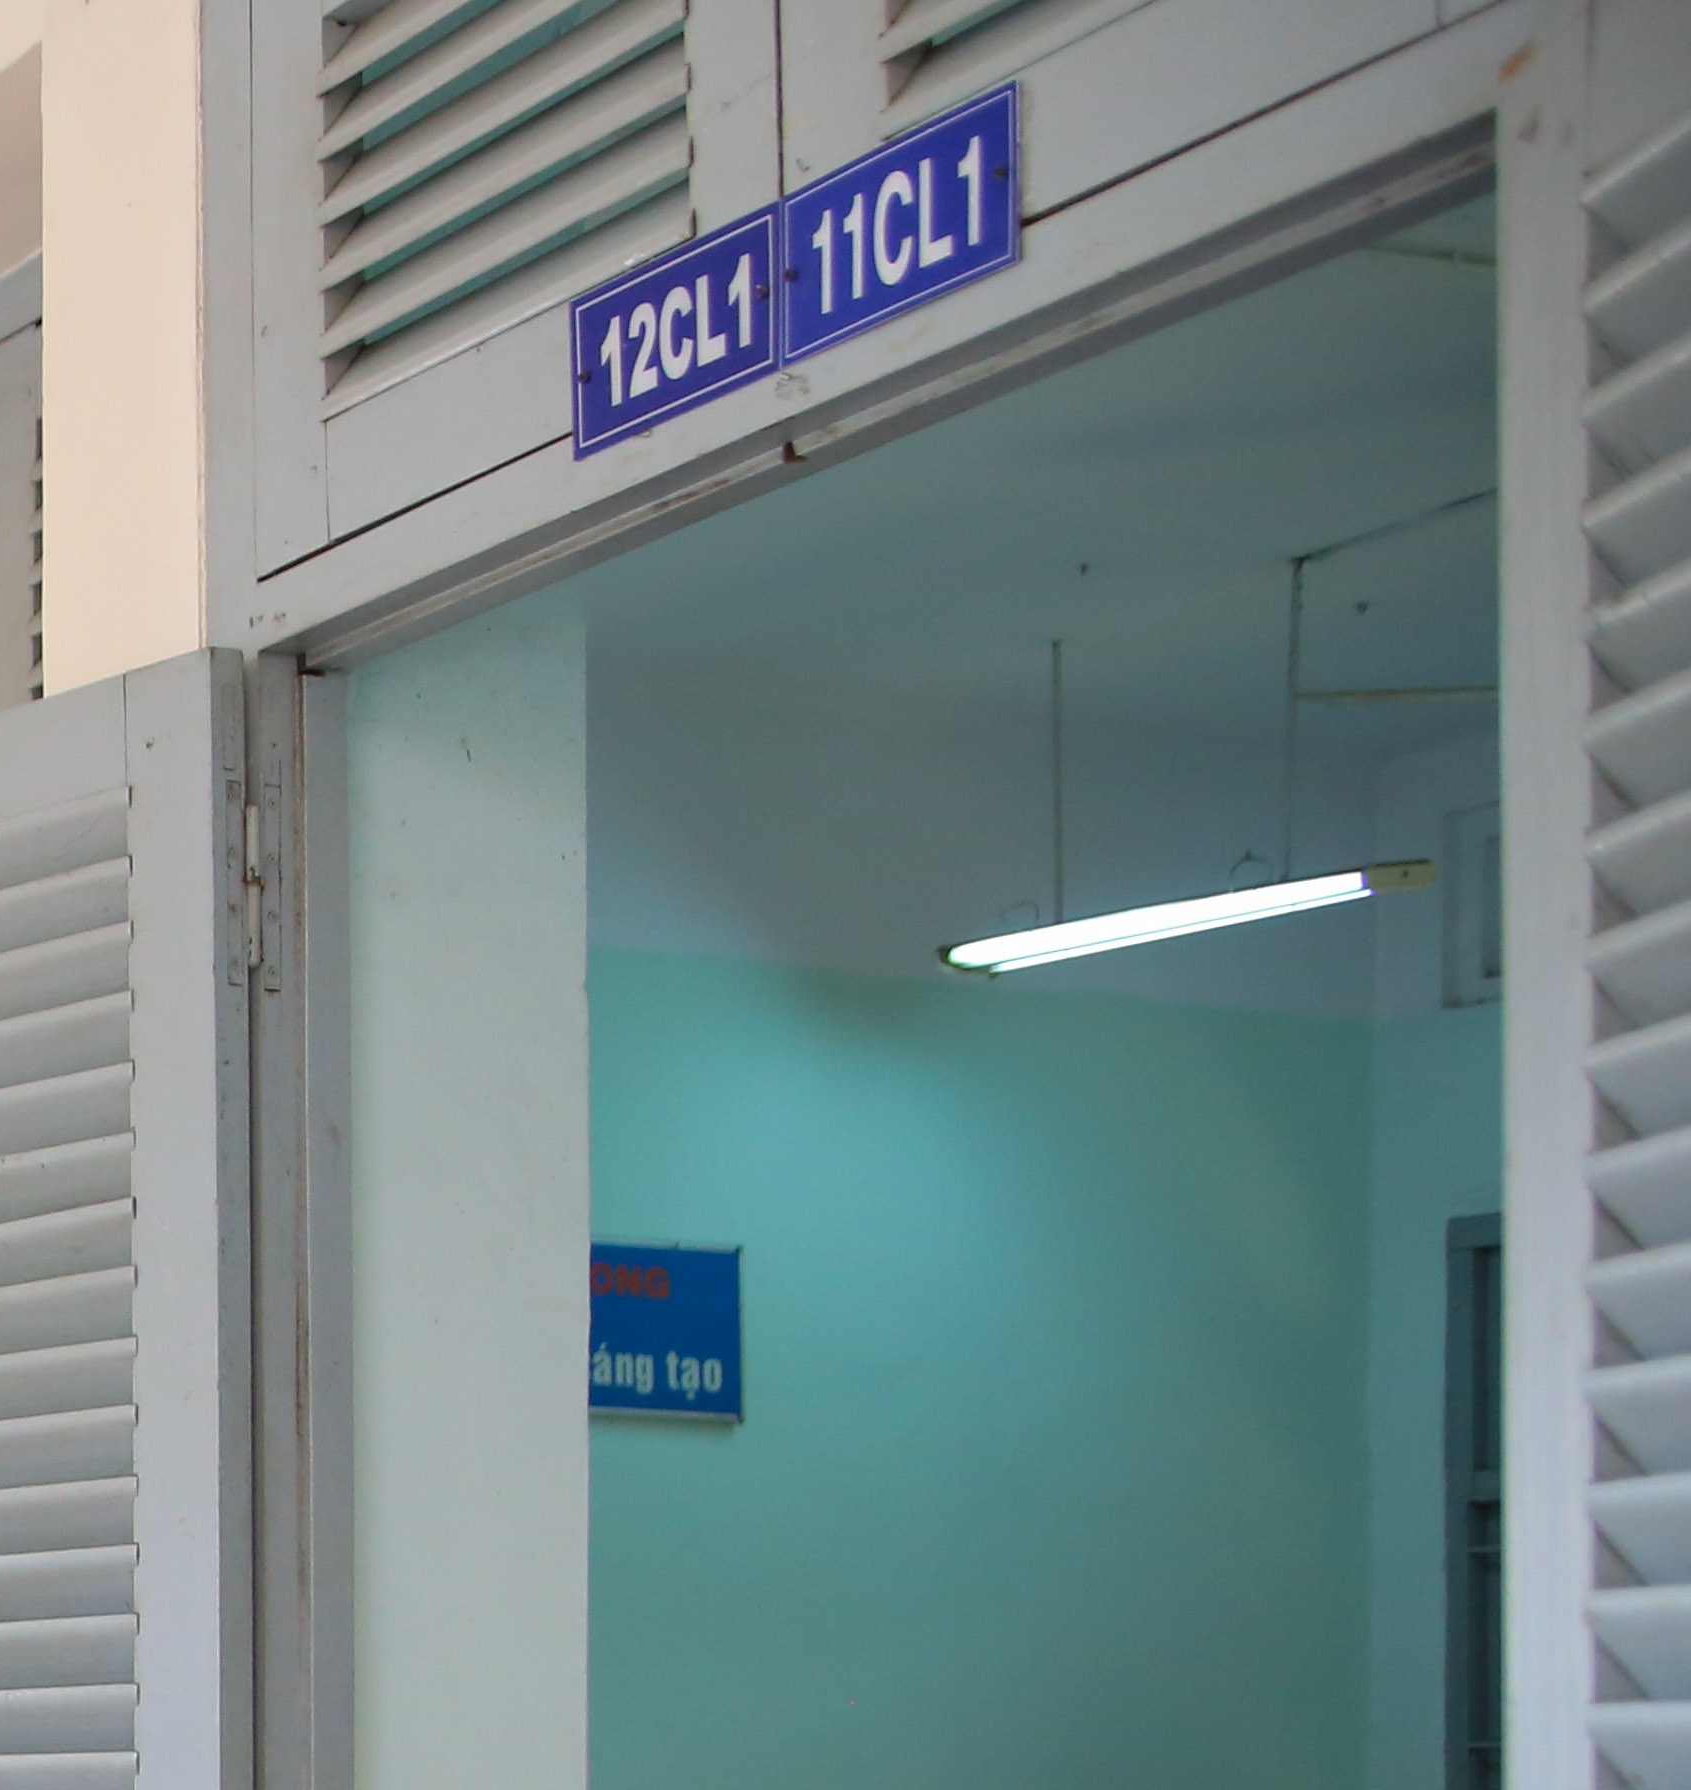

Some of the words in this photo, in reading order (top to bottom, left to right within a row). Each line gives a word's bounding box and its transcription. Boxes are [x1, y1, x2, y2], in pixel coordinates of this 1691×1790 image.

[812, 135, 983, 315] 11CL1
[600, 252, 752, 408] 12CL1
[589, 1262, 671, 1299] ONG
[591, 1342, 655, 1396] áng
[665, 1350, 724, 1401] tạo
